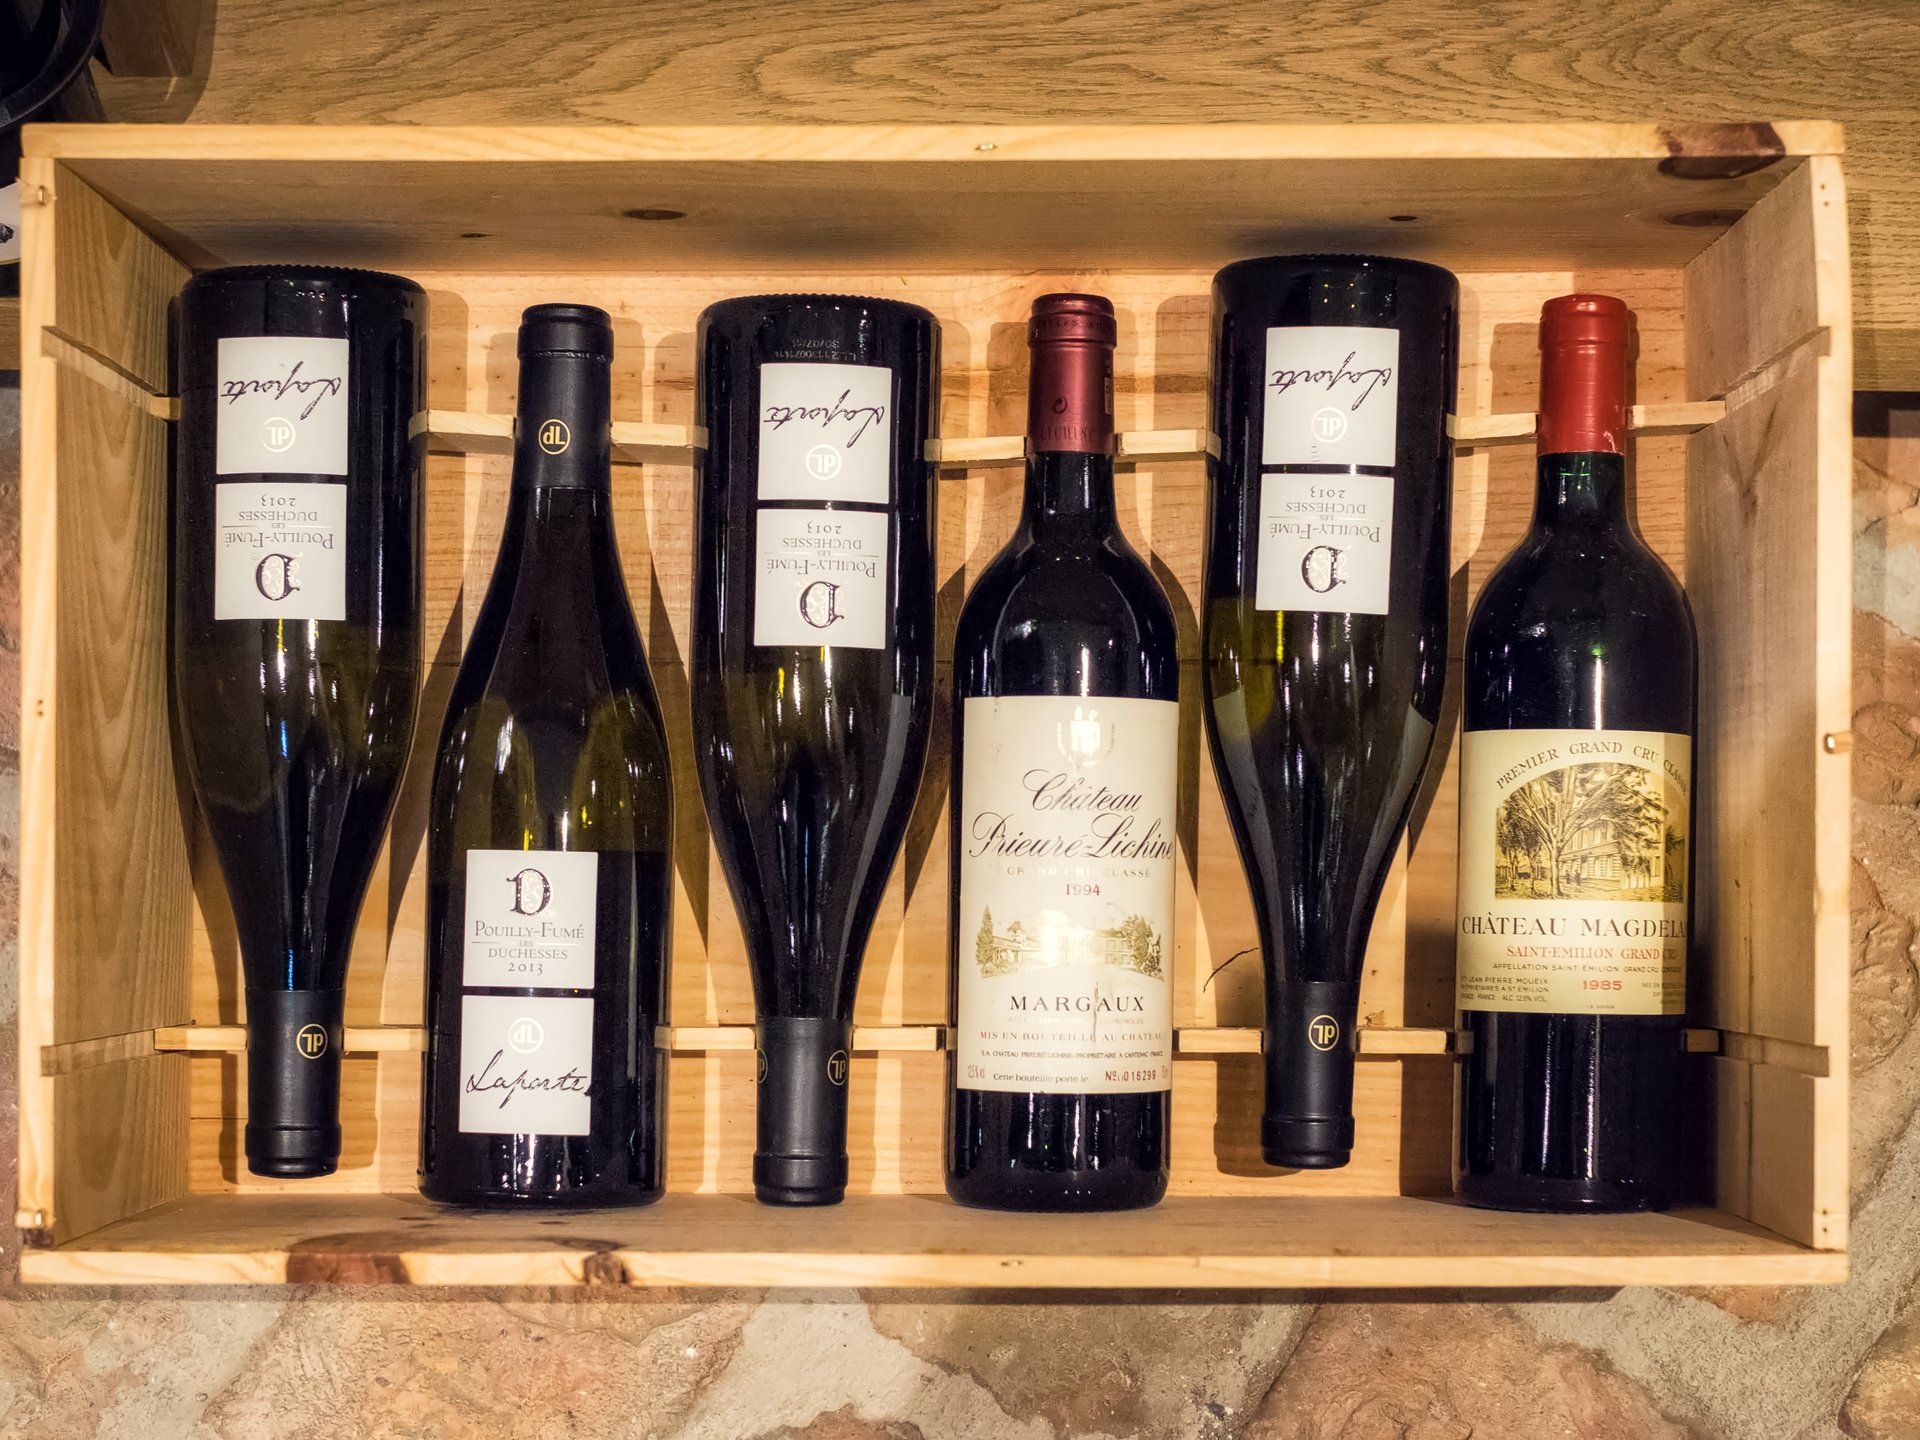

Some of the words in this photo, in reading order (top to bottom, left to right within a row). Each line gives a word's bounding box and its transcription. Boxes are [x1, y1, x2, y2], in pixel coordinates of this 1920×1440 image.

[1269, 351, 1391, 410] Laporte
[221, 361, 341, 420] Laporte
[764, 389, 884, 448] Laporte
[1310, 486, 1345, 498] 2013
[261, 494, 296, 507] 2013
[1286, 502, 1366, 514] DUCHESSES
[239, 511, 318, 521] DUCHESSES
[807, 521, 842, 534] 2013
[783, 538, 861, 550] DUCHESSES
[1497, 748, 1559, 789] PREMIER
[1569, 741, 1623, 755] GRAND
[1633, 745, 1659, 762] CRU
[1022, 769, 1142, 812] Château
[1065, 884, 1101, 896] 1994
[488, 947, 568, 960] DUCHESSES
[1507, 946, 1613, 959] SAINT-EMILION
[1621, 948, 1660, 960] GRAND
[508, 962, 543, 975] 2013
[1493, 963, 1548, 971] APPELLATION
[1485, 976, 1513, 984] PIERRE
[1583, 980, 1622, 991] 1985
[1010, 995, 1144, 1012] MARGAUX
[980, 1031, 998, 1040] MIS
[1002, 1032, 1017, 1040] EN
[1023, 1032, 1095, 1041] BOUTEILLE
[1103, 1032, 1118, 1041] AU
[466, 1048, 592, 1109] Laporte
[993, 1073, 1014, 1081] Cette
[1015, 1073, 1054, 1083] bouteille
[1055, 1075, 1076, 1085] porte
[1078, 1075, 1089, 1083] le
